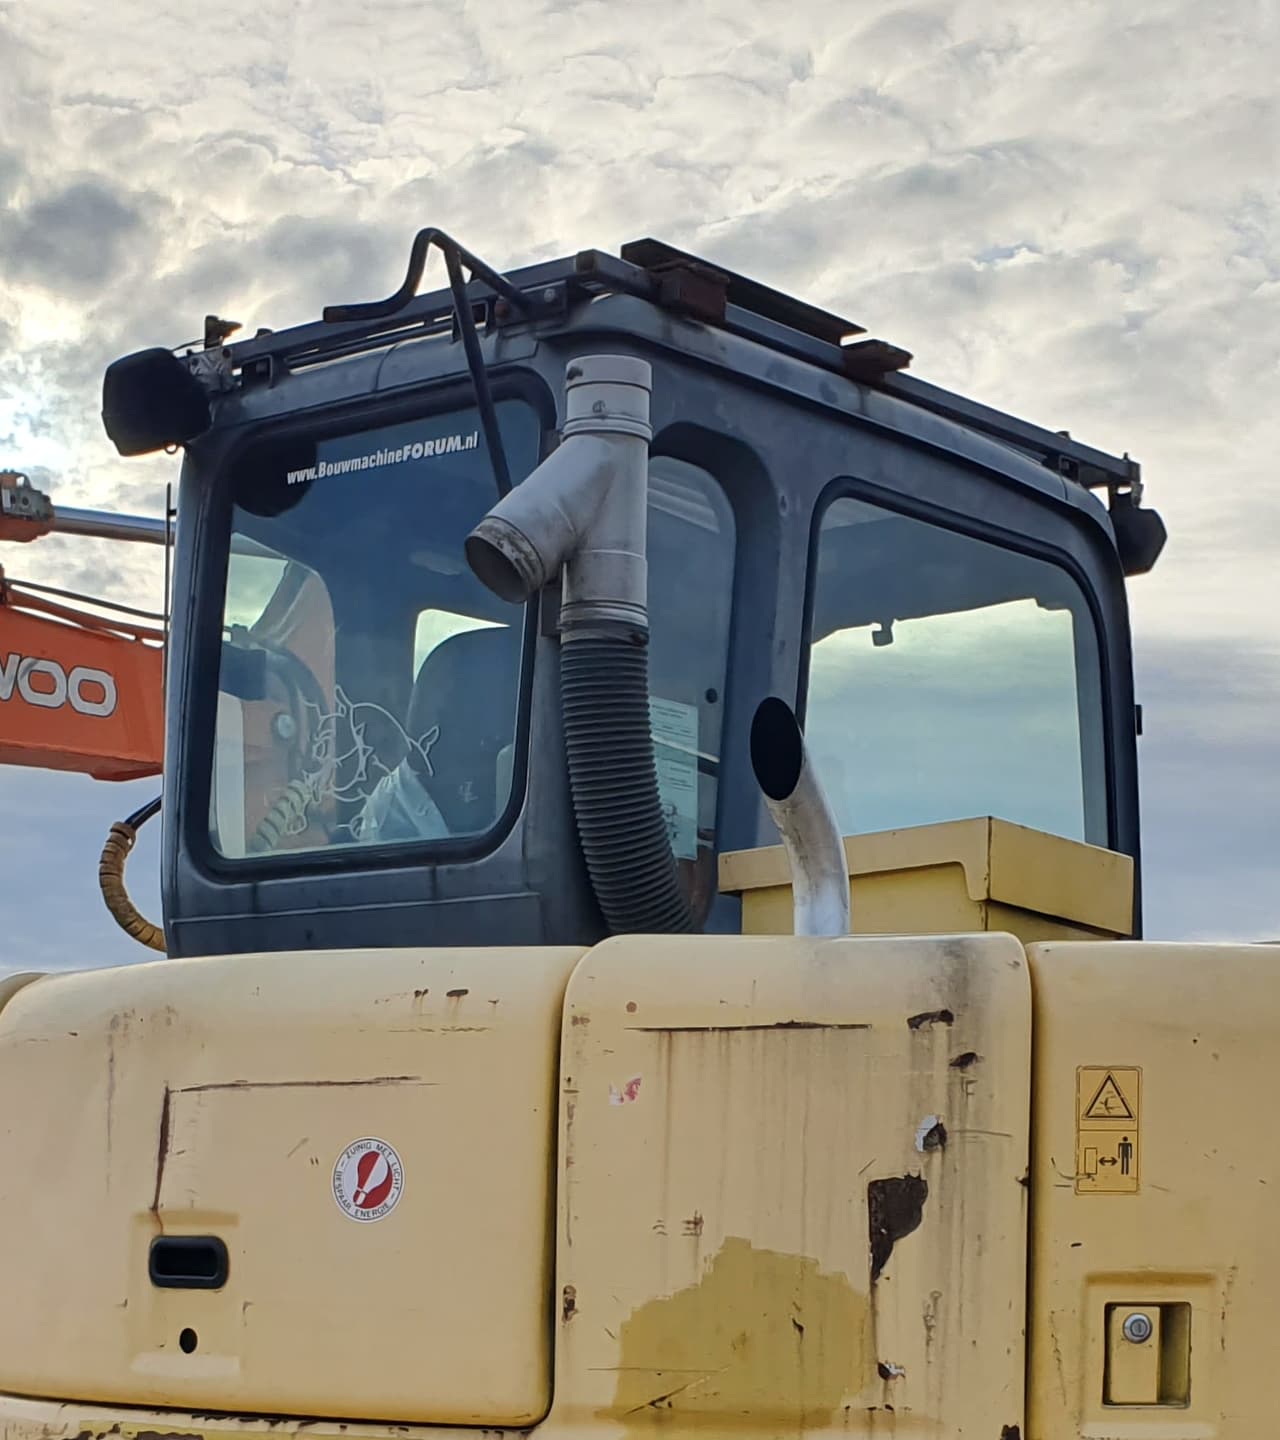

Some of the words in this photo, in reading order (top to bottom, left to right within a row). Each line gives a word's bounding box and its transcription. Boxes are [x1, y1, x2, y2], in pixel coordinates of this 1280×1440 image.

[287, 431, 478, 484] www.BouwmachineFORUM.nl
[346, 1142, 372, 1159] ZUINIG
[376, 1144, 392, 1158] MET
